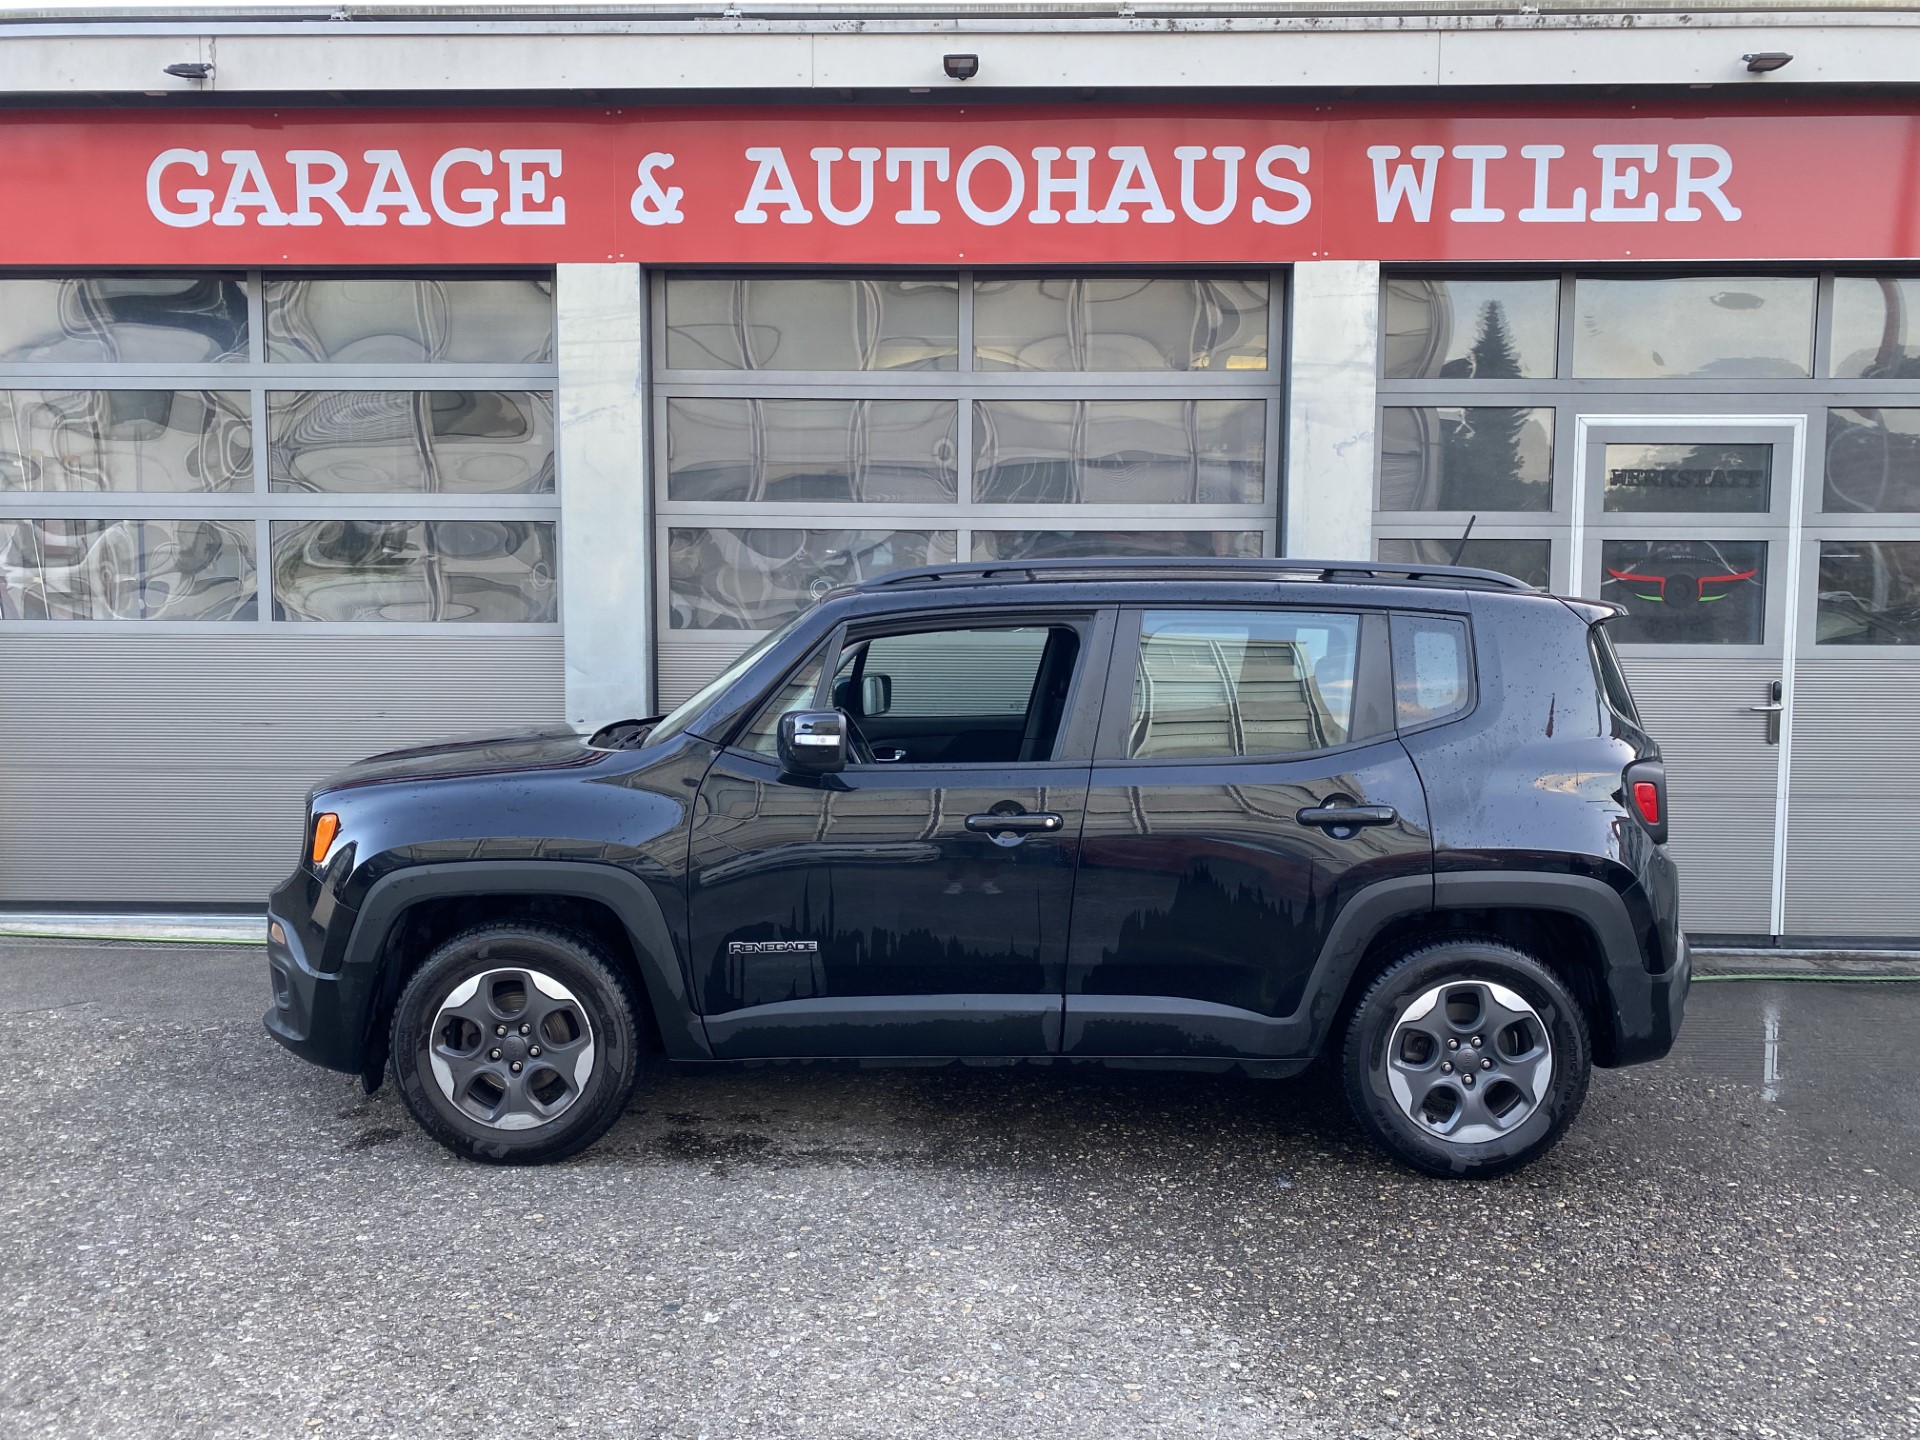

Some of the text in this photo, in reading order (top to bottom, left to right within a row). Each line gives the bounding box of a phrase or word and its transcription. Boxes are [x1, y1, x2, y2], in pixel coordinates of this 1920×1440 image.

[146, 143, 1742, 229] GARAGE & AUTOHAUS WILER
[728, 941, 818, 954] RENEGADE
